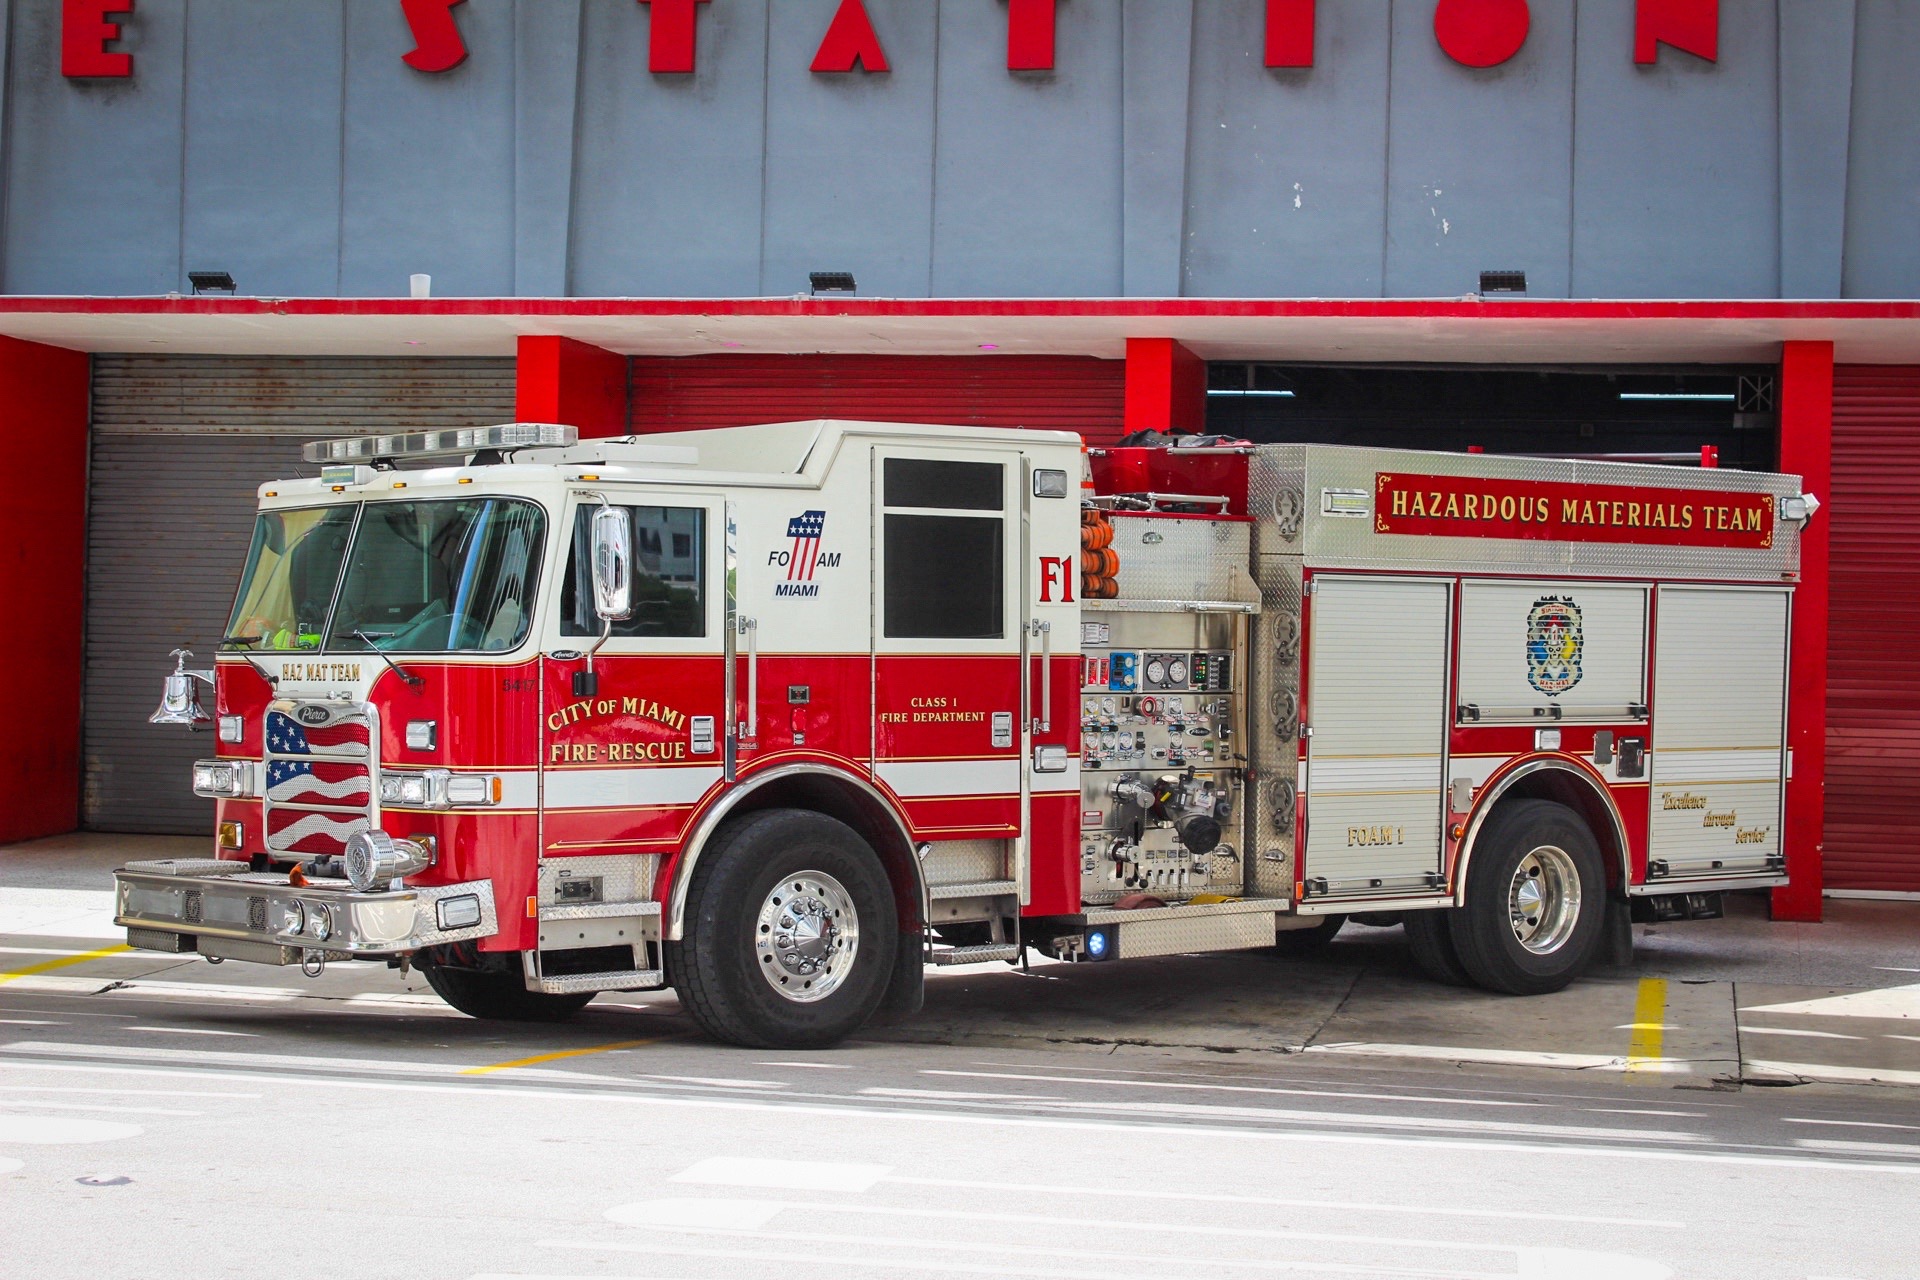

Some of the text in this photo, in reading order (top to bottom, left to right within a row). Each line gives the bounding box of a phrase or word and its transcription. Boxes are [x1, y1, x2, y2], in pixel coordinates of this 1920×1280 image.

[1391, 490, 1763, 532] HAZARDOUS MATERIALS TEAM
[1039, 555, 1075, 602] F1
[775, 584, 819, 597] MIAMI
[282, 663, 361, 682] HAZ MAT TEAM
[502, 678, 536, 692] 5417
[910, 697, 947, 708] CLASS
[301, 706, 327, 721] Pierce
[547, 696, 687, 732] CITY OF MIAMI
[881, 711, 986, 723] FIRE DEPARTMENT
[1703, 808, 1737, 830] through
[1347, 824, 1405, 847] FOAM 1
